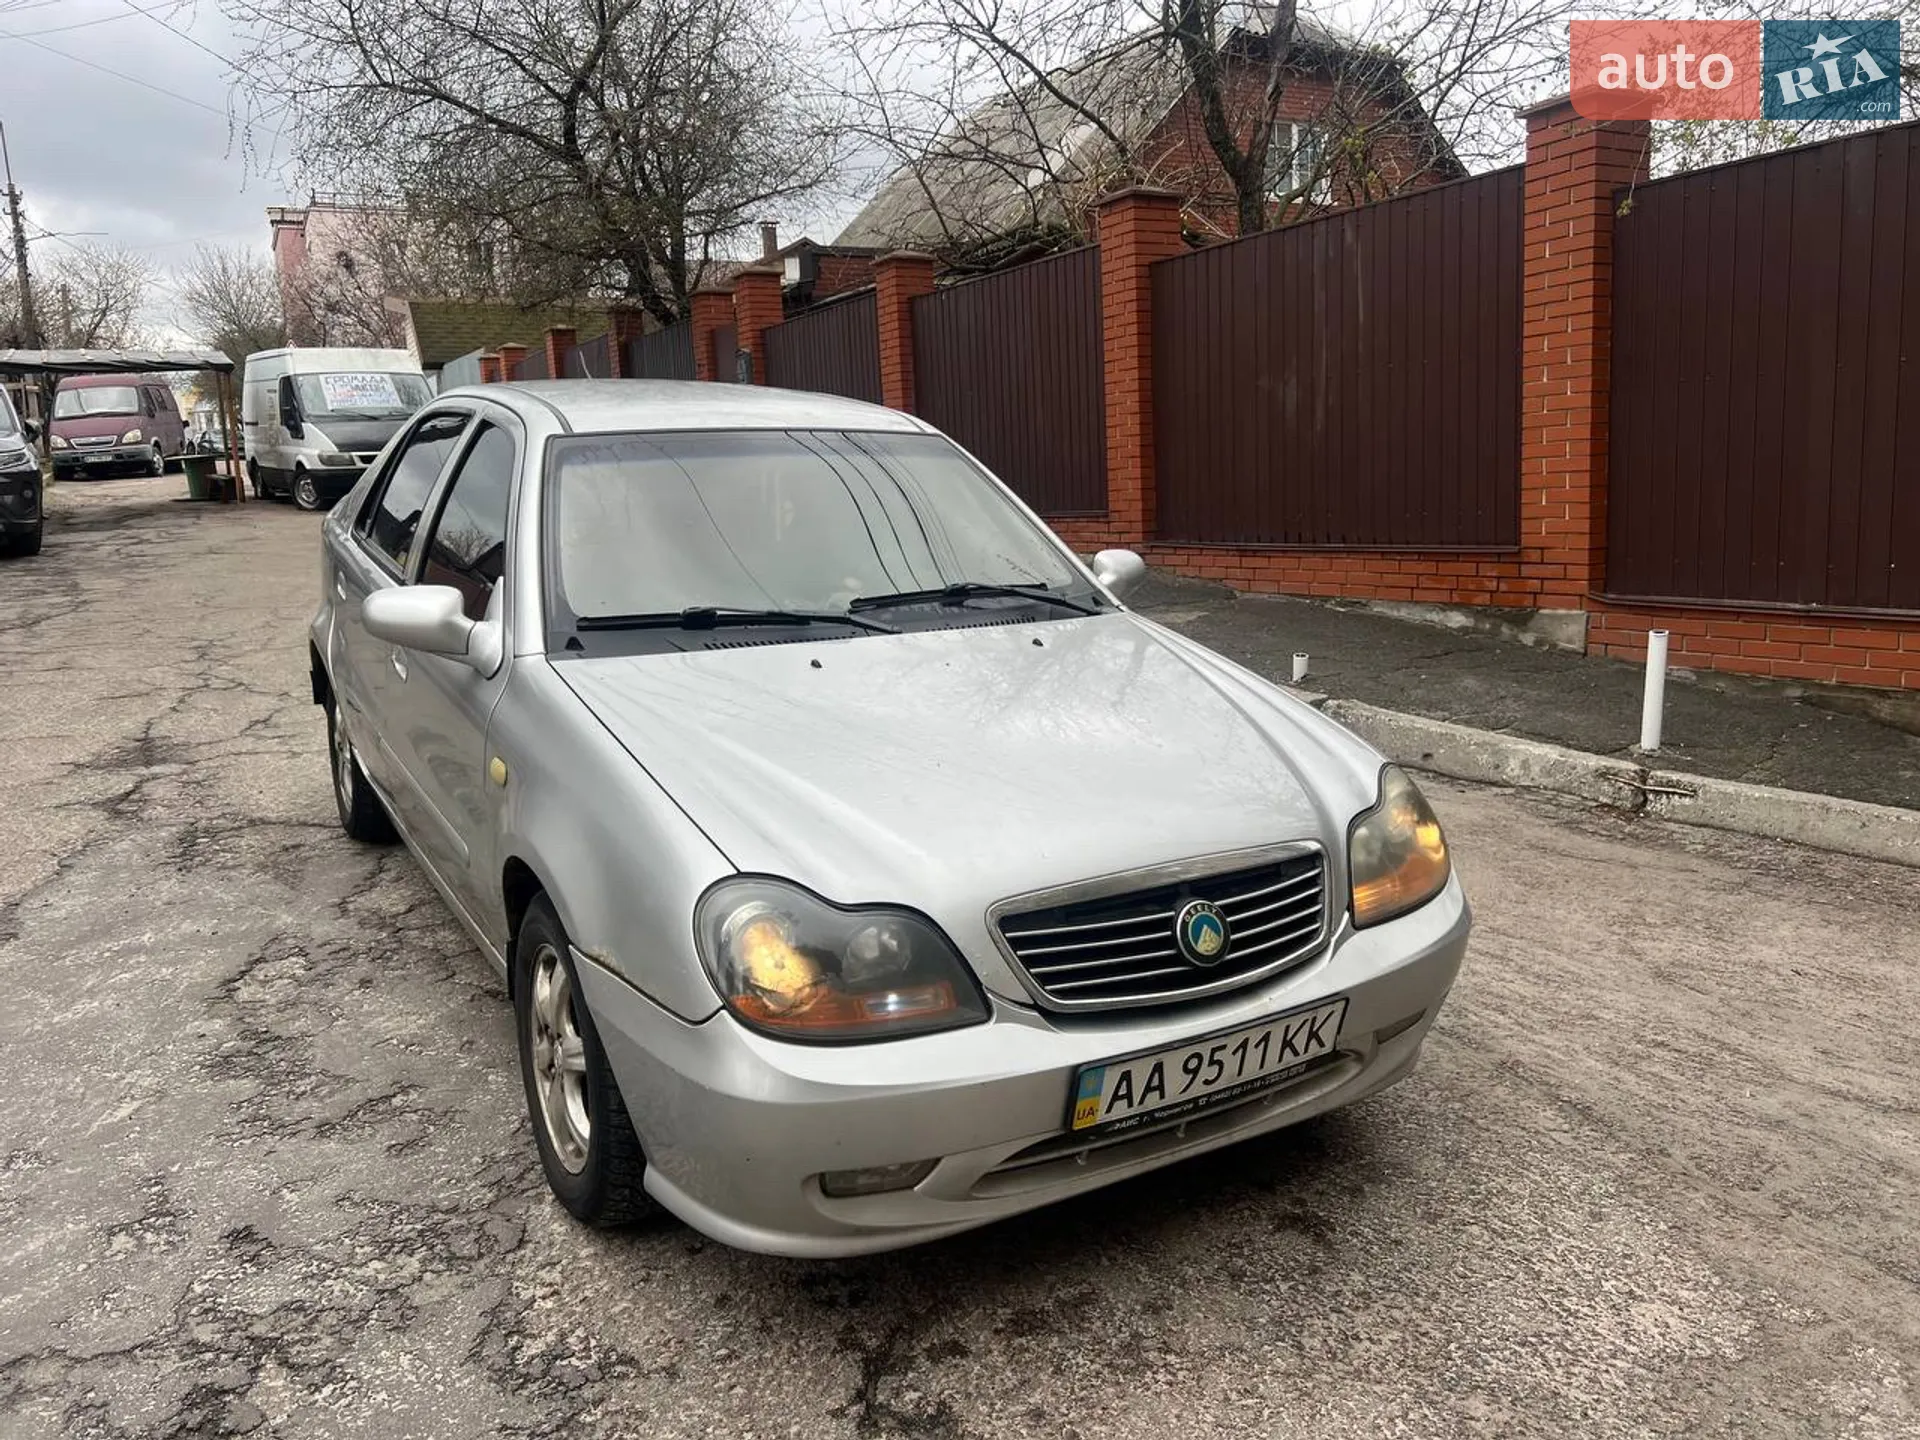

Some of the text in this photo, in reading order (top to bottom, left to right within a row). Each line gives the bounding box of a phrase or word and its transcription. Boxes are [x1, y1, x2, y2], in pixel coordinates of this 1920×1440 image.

[1105, 1061, 1167, 1115] AA
[1178, 1030, 1272, 1095] 9511
[1278, 1010, 1335, 1063] KK
[1076, 1106, 1096, 1121] UA
